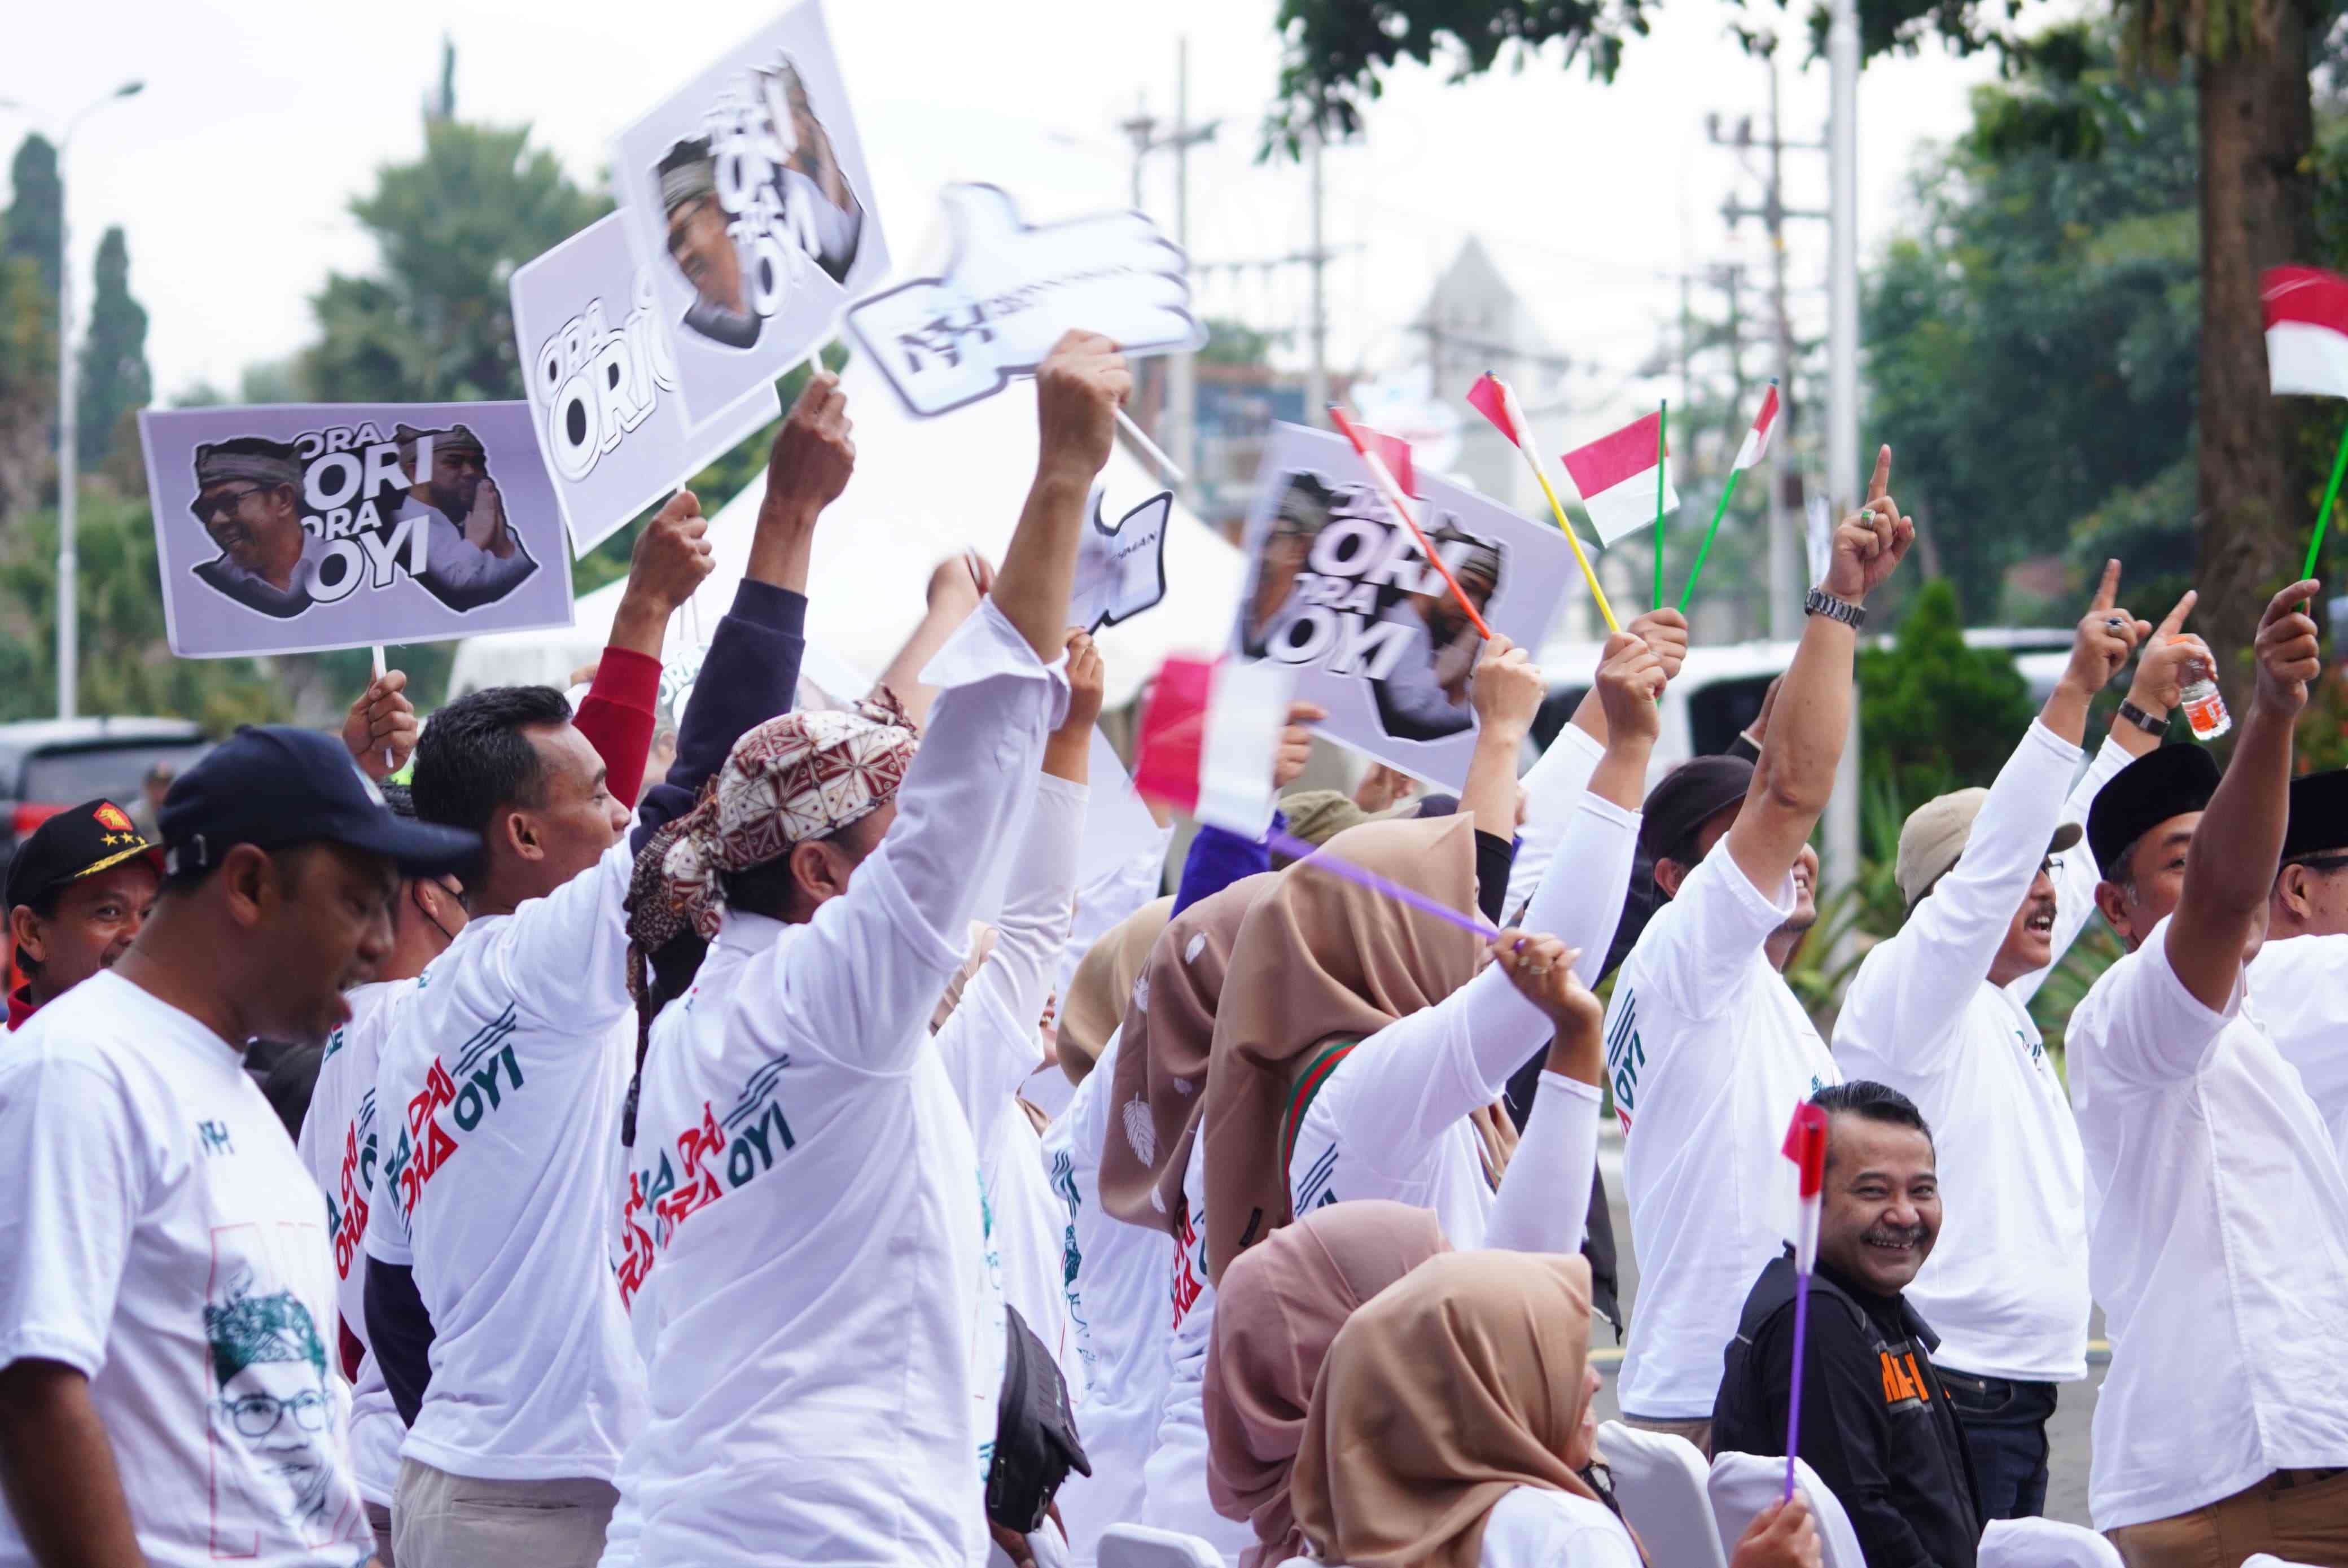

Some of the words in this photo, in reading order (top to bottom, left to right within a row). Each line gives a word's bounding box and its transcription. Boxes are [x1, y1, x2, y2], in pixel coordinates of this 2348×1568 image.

[539, 299, 608, 402] ORA
[552, 315, 654, 473] ORI
[294, 422, 385, 460] ORA
[303, 435, 434, 511] ORI
[300, 499, 383, 542] ORA
[305, 514, 430, 602] OYI
[453, 1043, 524, 1132] OYI
[1615, 1028, 1646, 1111] OYI
[728, 1100, 795, 1189] OYI
[336, 1184, 369, 1281] ORA
